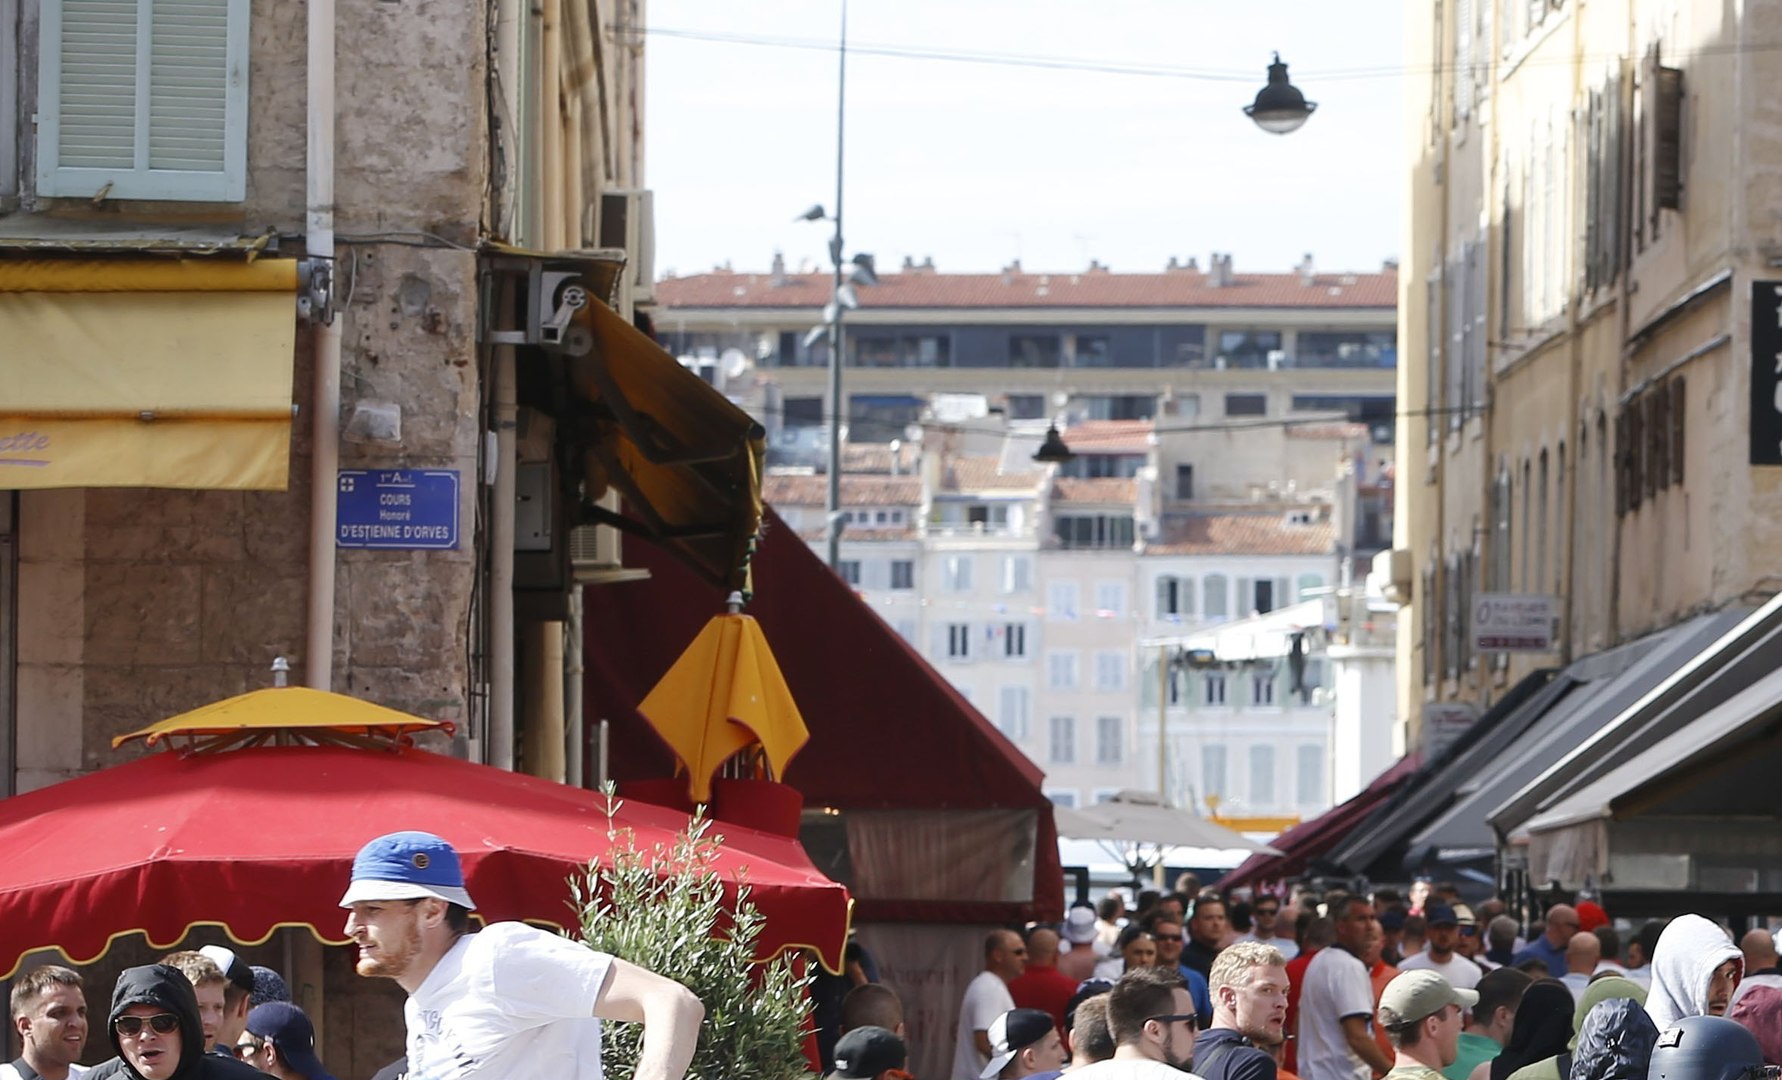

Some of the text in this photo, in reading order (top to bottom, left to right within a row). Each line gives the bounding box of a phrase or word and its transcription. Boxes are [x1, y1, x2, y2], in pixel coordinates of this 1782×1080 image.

[379, 494, 412, 506] COURS
[379, 509, 411, 521] Honoré
[341, 524, 449, 540] D'ESTIENNE D'ORVES
